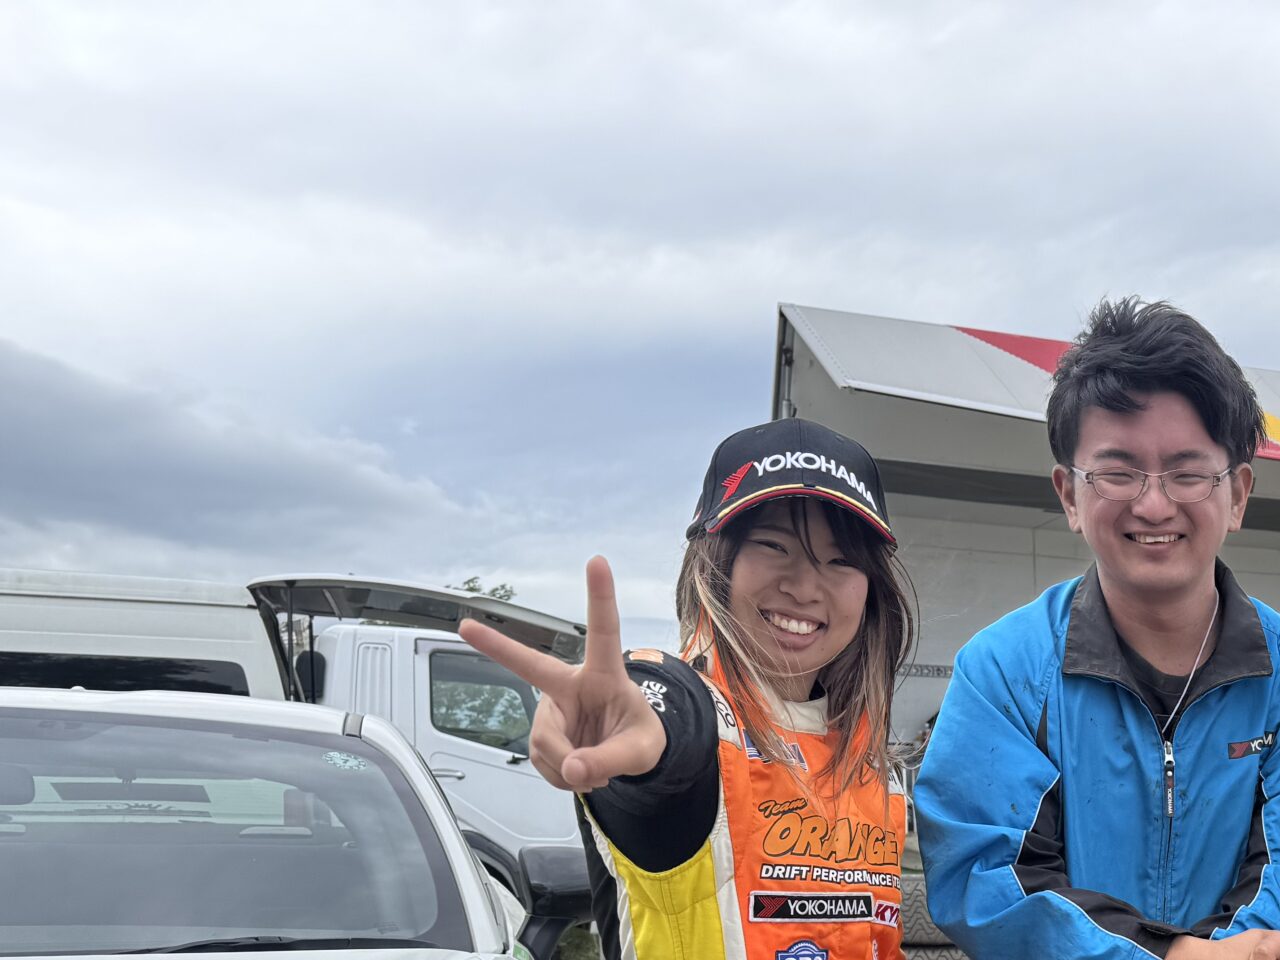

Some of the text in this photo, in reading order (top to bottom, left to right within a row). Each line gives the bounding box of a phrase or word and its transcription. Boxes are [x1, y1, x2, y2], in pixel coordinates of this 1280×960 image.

[753, 451, 878, 511] YOKOHAMA
[758, 797, 808, 819] Team
[762, 812, 899, 867] ORANGE
[760, 864, 811, 881] DRIFT
[788, 899, 868, 916] YOKOHAMA
